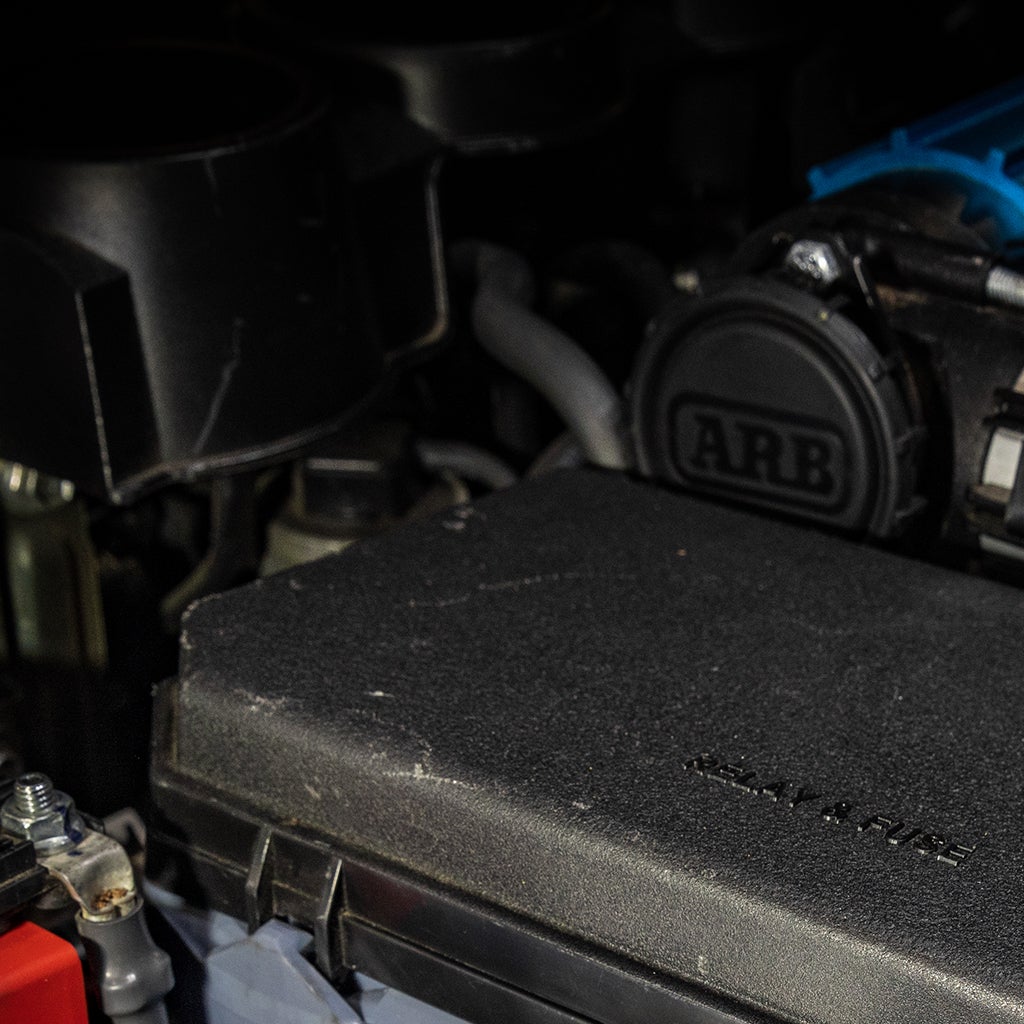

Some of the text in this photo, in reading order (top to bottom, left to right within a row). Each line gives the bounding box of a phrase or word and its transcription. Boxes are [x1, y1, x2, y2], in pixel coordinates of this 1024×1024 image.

[689, 412, 834, 496] ARB
[683, 752, 977, 867] RELAY & FUSE
